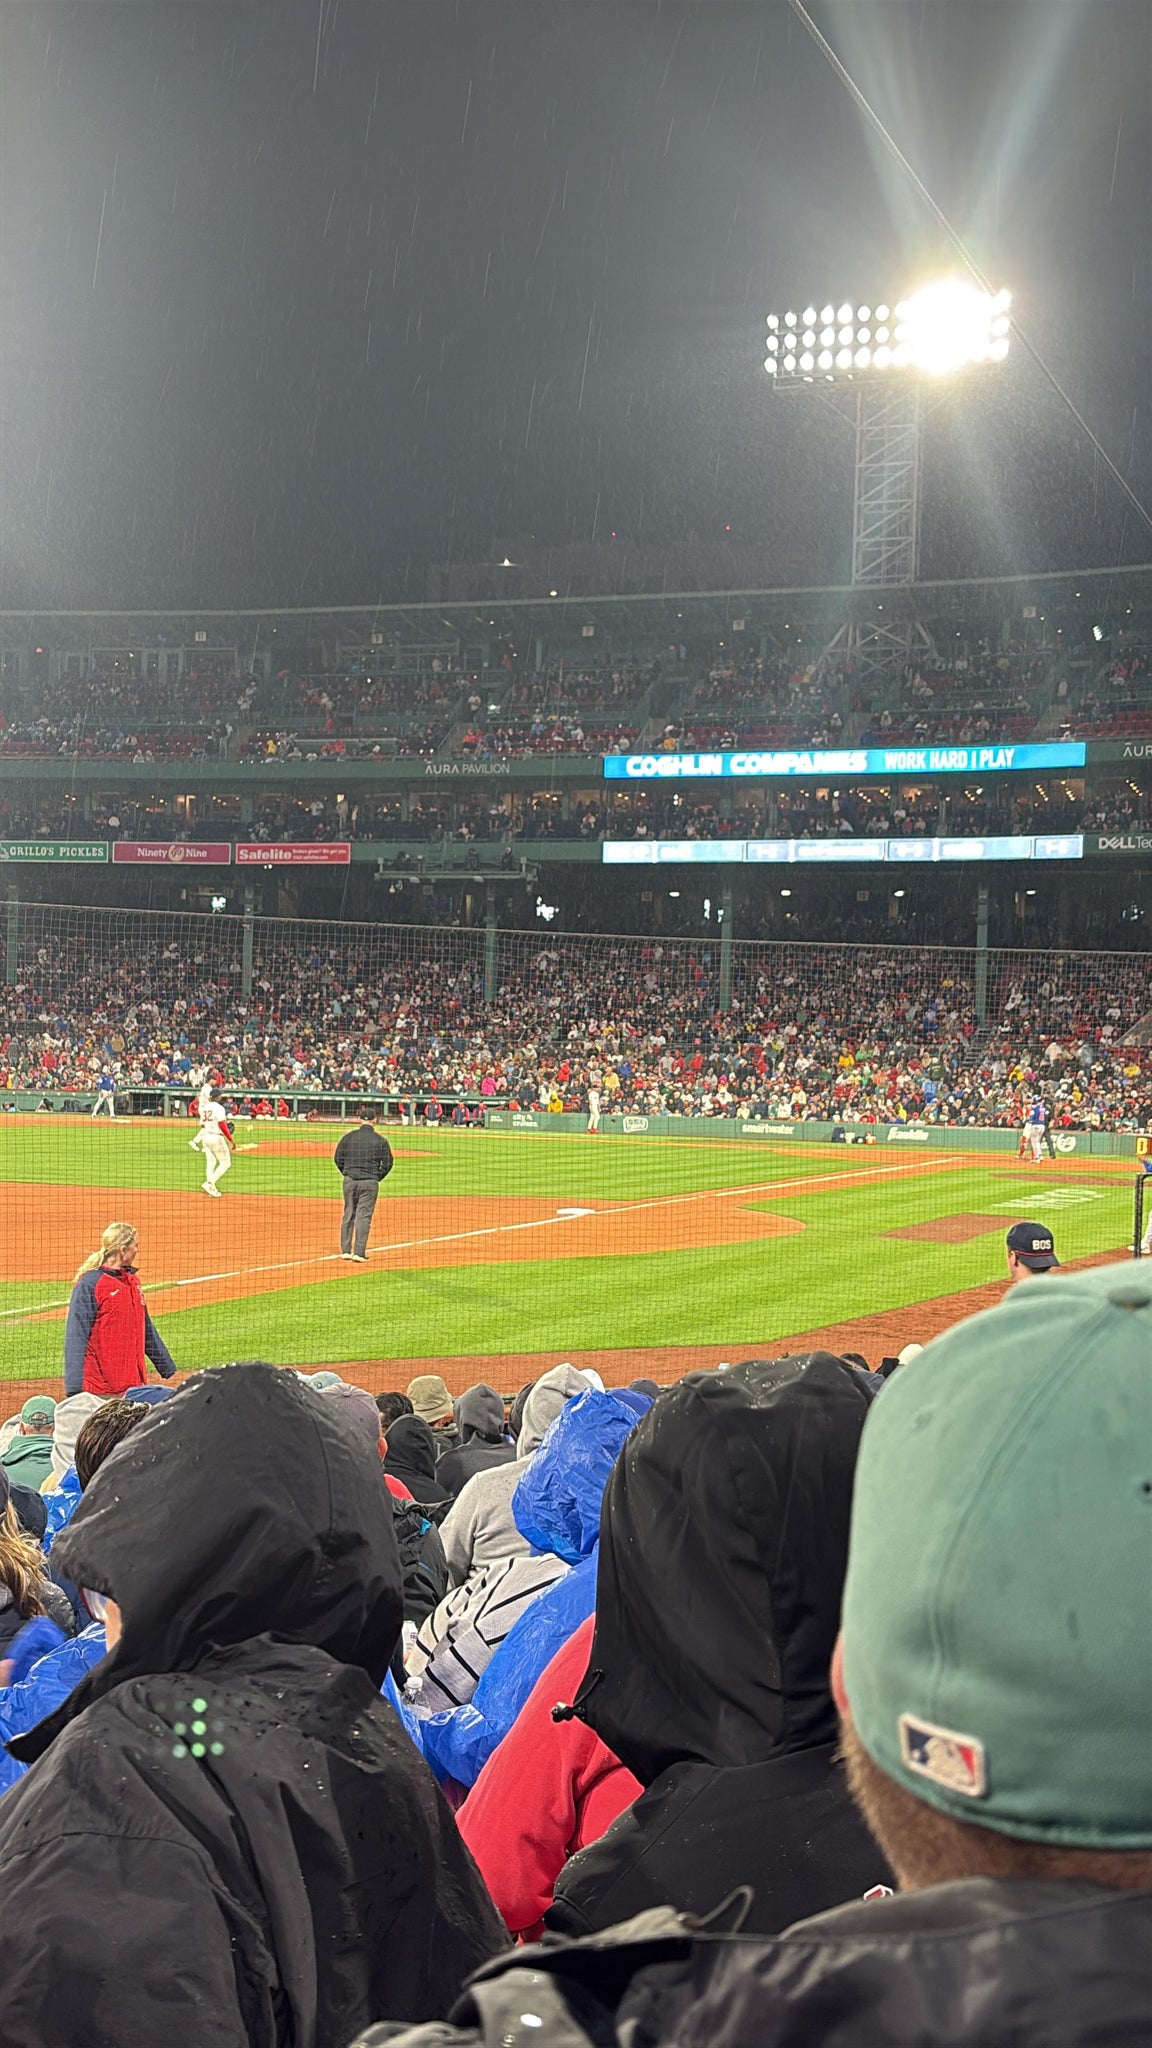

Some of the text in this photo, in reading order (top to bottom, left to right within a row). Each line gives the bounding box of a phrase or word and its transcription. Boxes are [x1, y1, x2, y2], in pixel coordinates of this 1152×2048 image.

[884, 752, 926, 769] WORK
[929, 750, 968, 769] HARD
[980, 748, 1015, 768] PLAY
[462, 763, 510, 774] PAVILION
[1098, 836, 1136, 849] DELL
[9, 846, 104, 856] GRILLO'S PICKLES
[136, 848, 168, 859] Ninety
[186, 848, 208, 858] Nine
[239, 849, 292, 860] Safelite
[203, 1110, 213, 1122] 32
[742, 1123, 795, 1135] smartwater
[1032, 1239, 1052, 1251] BOS
